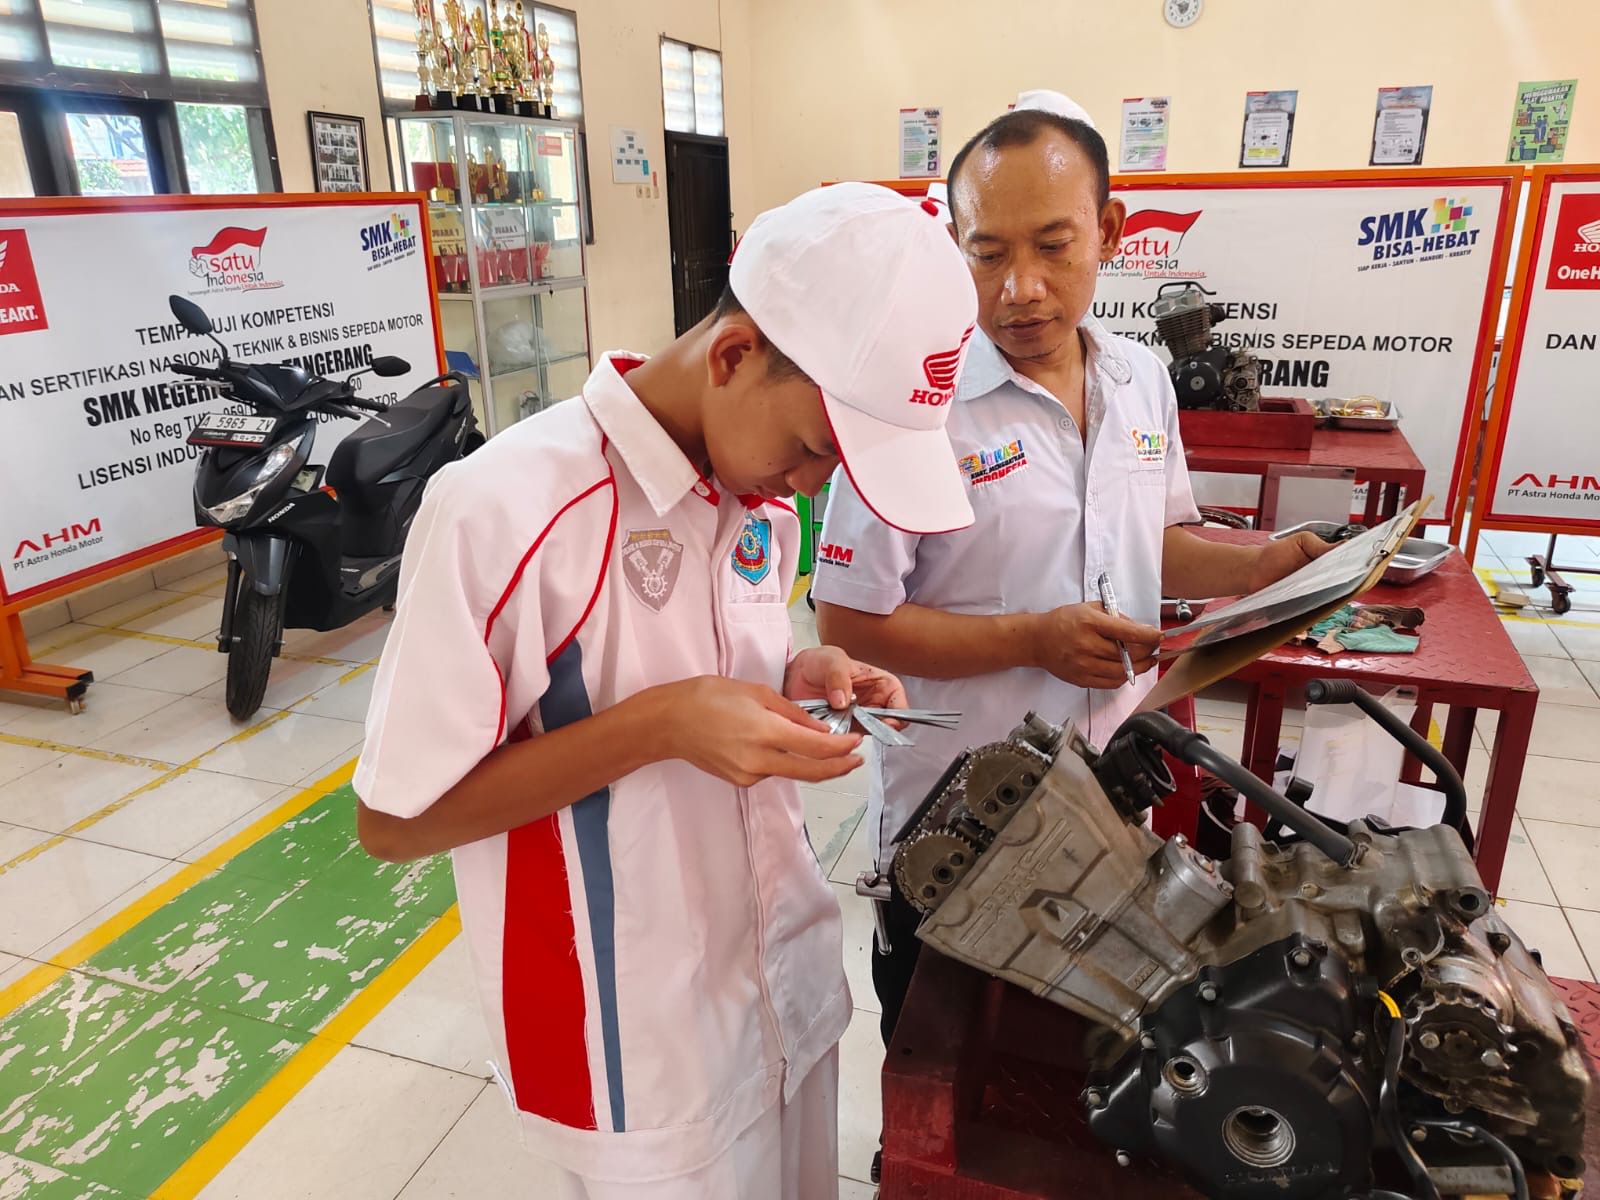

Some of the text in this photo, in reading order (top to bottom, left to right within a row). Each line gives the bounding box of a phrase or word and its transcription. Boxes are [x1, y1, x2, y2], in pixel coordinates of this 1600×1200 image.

[361, 220, 392, 251] SMK
[1358, 208, 1428, 246] SMK
[372, 235, 416, 262] BISA-HEBAT
[1373, 229, 1480, 261] BISA-HEBAT
[210, 253, 255, 274] satu
[203, 271, 264, 287] Indonesia
[135, 302, 335, 345] TEMP UJI KOMPETENSI
[1092, 302, 1124, 319] UJI
[32, 360, 146, 396] SERTIFIKASI
[149, 347, 225, 374] NASIONA
[233, 336, 285, 358] TEKNIK
[287, 335, 298, 349] &
[300, 326, 339, 347] BISNIS
[342, 320, 386, 339] SEPEDA
[387, 313, 424, 332] MOTOR
[1210, 332, 1276, 349] BISNIS
[1282, 333, 1366, 351] SEPEDA
[1372, 335, 1453, 353] MOTOR
[1546, 333, 1596, 350] DAN
[84, 389, 141, 427] SMK
[282, 344, 373, 376] ANGERANG
[130, 429, 151, 446] No
[154, 422, 182, 439] Reg
[216, 416, 247, 429] 5965
[78, 455, 151, 490] LISENSI
[1508, 488, 1520, 497] PT
[1521, 490, 1547, 498] Astra
[1549, 491, 1581, 500] Honda
[267, 503, 295, 523] HONDA
[14, 518, 102, 559] AHM
[14, 535, 104, 571] PT Astra Honda Motor
